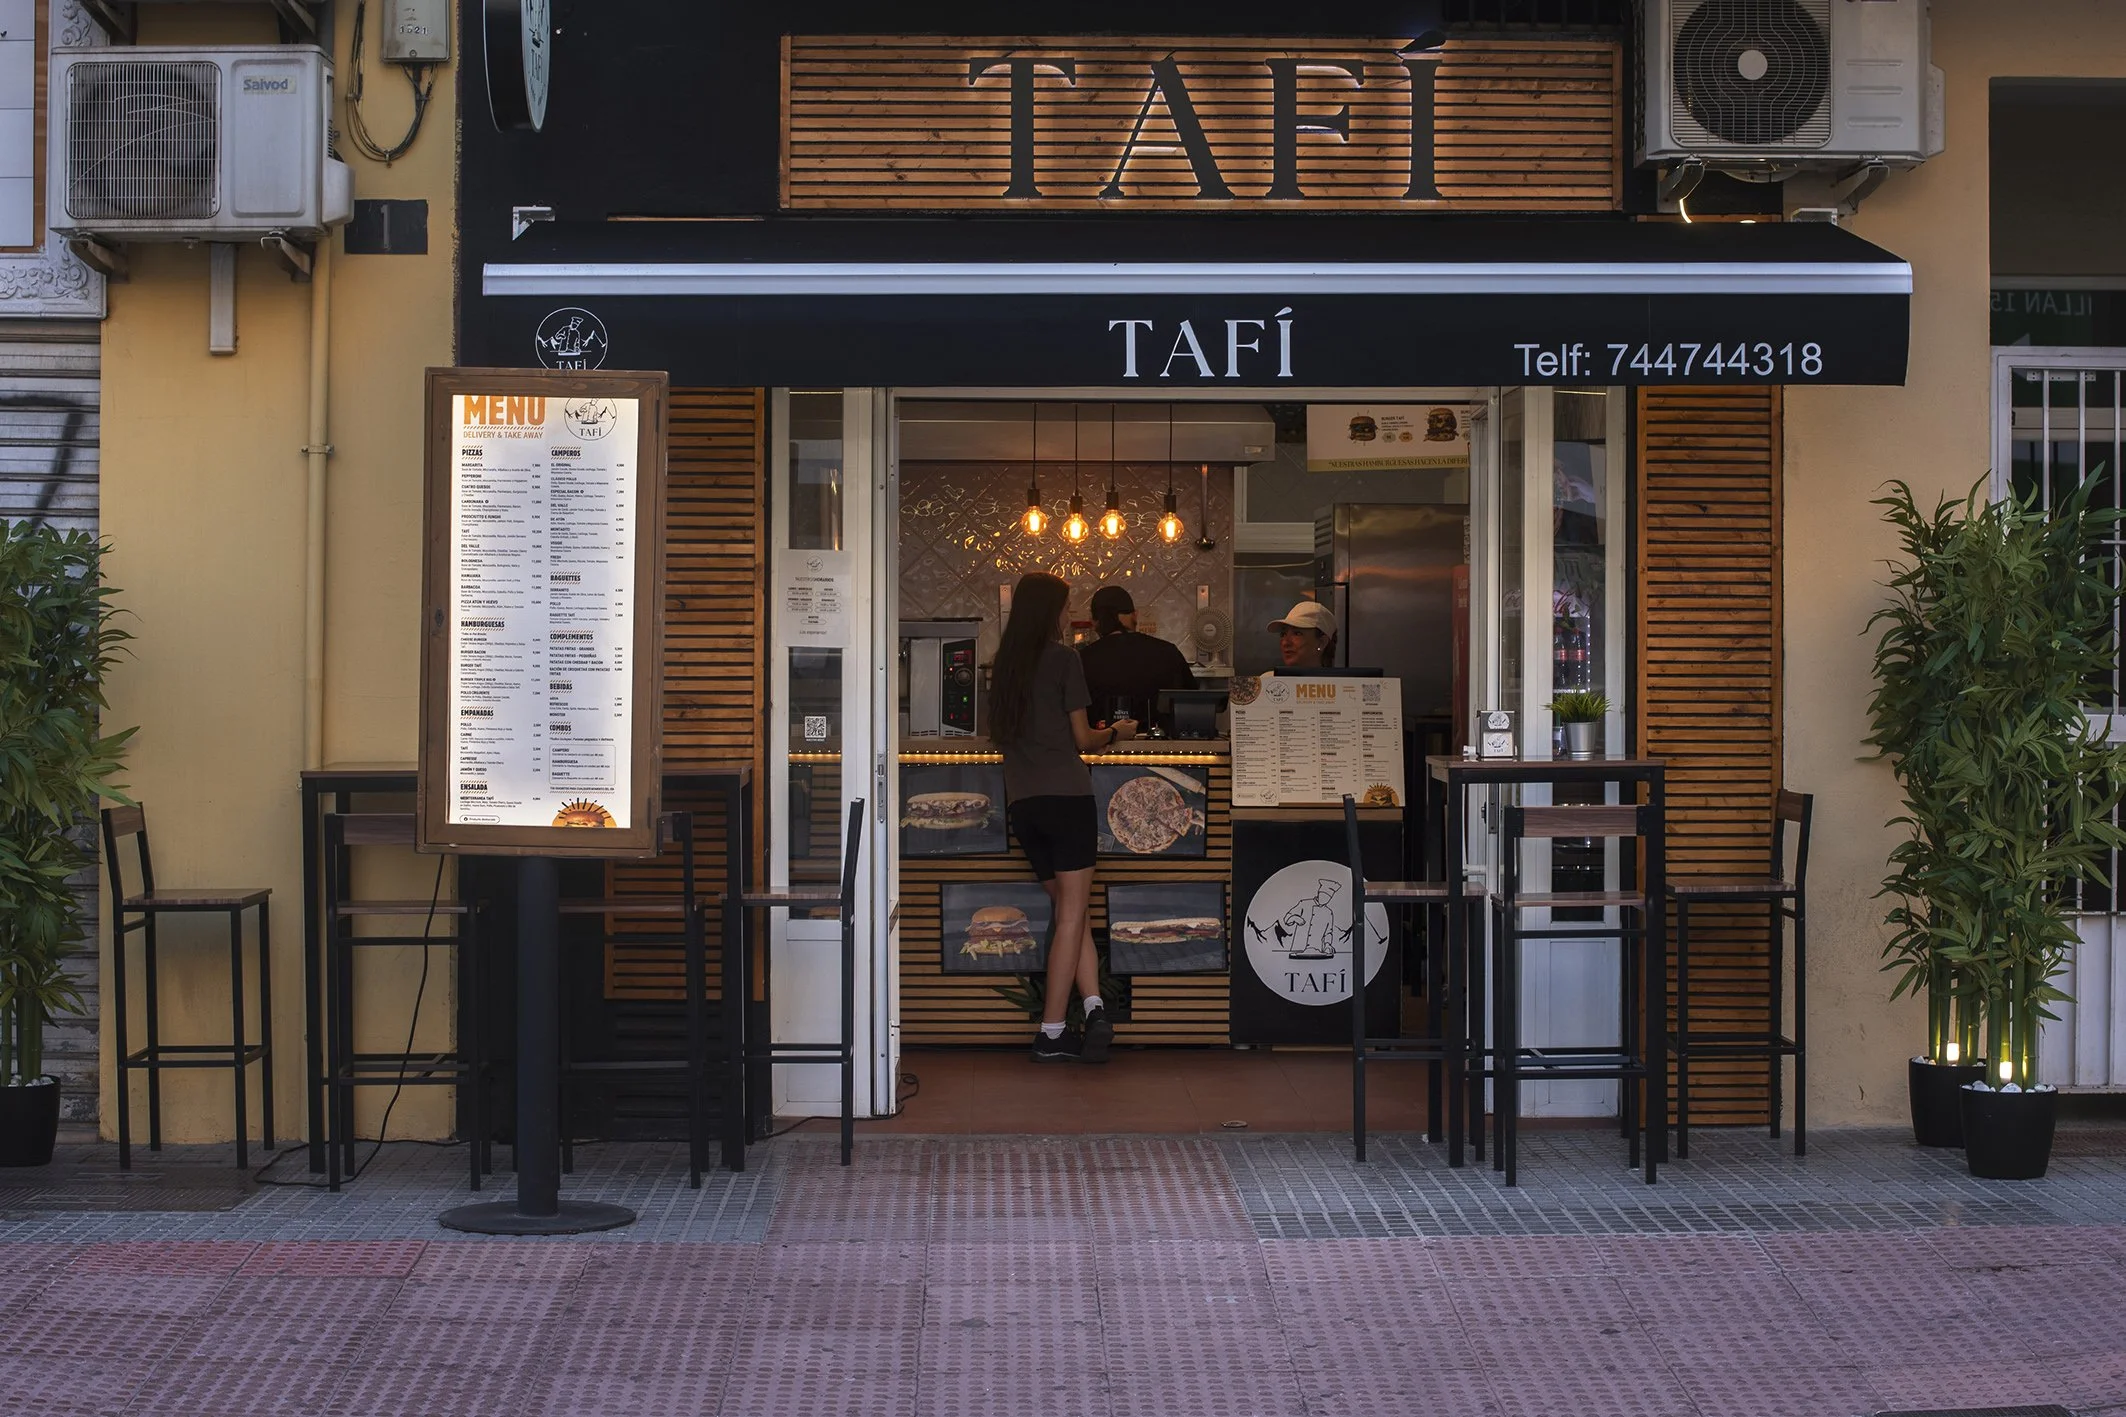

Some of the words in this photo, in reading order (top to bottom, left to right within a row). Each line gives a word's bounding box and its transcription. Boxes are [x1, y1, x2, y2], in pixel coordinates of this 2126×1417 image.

[244, 78, 288, 90] Saivod
[970, 30, 1445, 200] TAFÍ
[1108, 306, 1294, 377] TAFÍ
[1514, 343, 1591, 376] Telf:
[1606, 342, 1824, 376] 744744318
[580, 426, 602, 437] TAFÍ
[1296, 684, 1336, 698] MENU
[1284, 968, 1346, 992] TAFÍ
